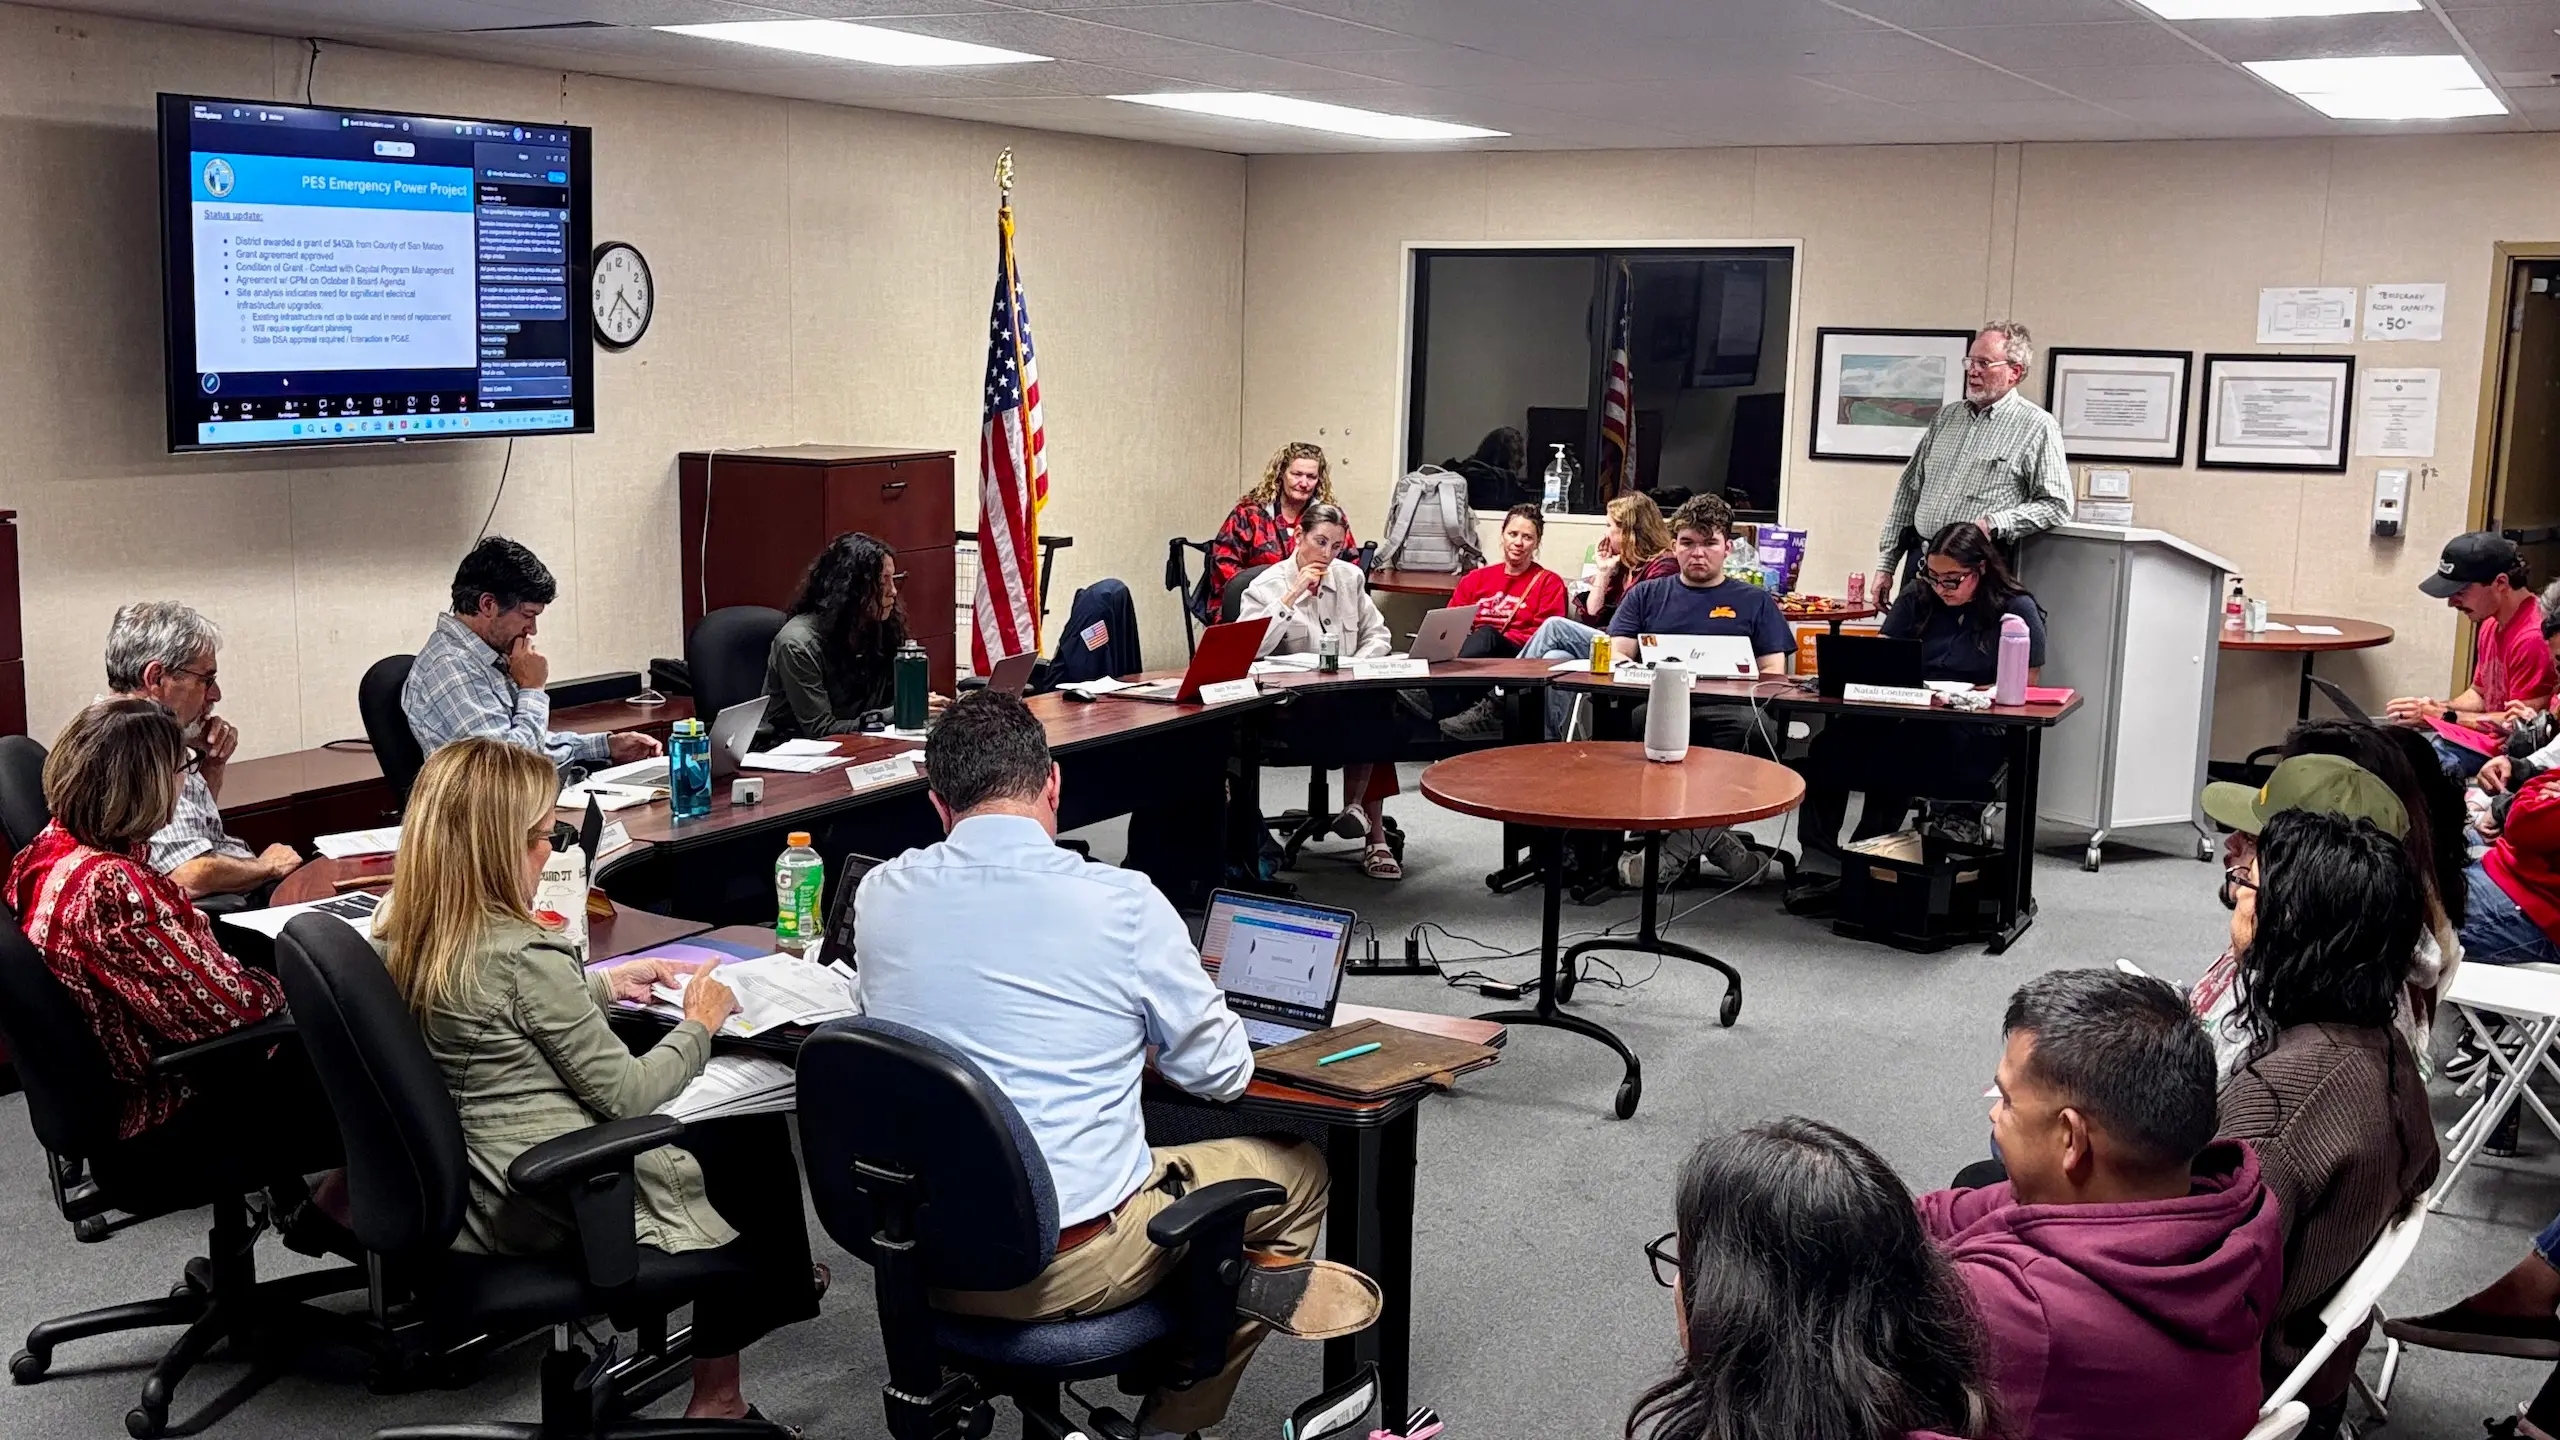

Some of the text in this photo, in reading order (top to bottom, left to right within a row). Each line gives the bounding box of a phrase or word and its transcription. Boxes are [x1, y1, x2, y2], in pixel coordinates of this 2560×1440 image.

[302, 175, 326, 190] PES
[329, 177, 391, 196] Emergency
[394, 180, 427, 194] Power
[430, 182, 467, 198] Project
[204, 209, 263, 222] Status update:
[235, 236, 261, 246] District
[263, 238, 295, 247] awarded
[304, 239, 322, 249] grant
[324, 239, 332, 247] of
[356, 240, 372, 248] from
[373, 240, 398, 251] County
[399, 241, 407, 250] of
[407, 241, 422, 250] San
[422, 242, 444, 250] Mateo
[236, 249, 334, 261] Grant agreement approved
[606, 261, 612, 272] 11
[615, 257, 622, 268] 12
[236, 262, 272, 272] Condition
[273, 263, 281, 272] of
[282, 263, 304, 272] Grant
[309, 263, 338, 273] Contact
[381, 264, 410, 276] Program
[411, 265, 455, 276] Management
[236, 275, 278, 286] Agreement
[289, 276, 308, 285] CPM
[309, 277, 320, 285] on
[320, 276, 349, 285] October
[357, 277, 378, 286] Board
[379, 277, 406, 287] Agenda
[598, 273, 606, 284] 10
[633, 272, 639, 283] 2
[236, 288, 416, 299] Site analysis indicates need for significant electrical
[595, 289, 600, 300] 9
[637, 289, 643, 301] 3
[236, 300, 286, 310] infrastructure
[599, 306, 604, 317] 8
[252, 313, 279, 323] Existing
[280, 313, 323, 321] infrastructure
[336, 314, 344, 322] up
[345, 313, 353, 321] to
[370, 313, 382, 321] and
[383, 313, 389, 321] in
[390, 313, 406, 321] need
[407, 312, 414, 321] of
[414, 313, 452, 322] replacement
[627, 317, 632, 329] 5
[252, 324, 353, 334] Will require significant planning
[617, 321, 623, 333] 6
[252, 335, 271, 344] State
[272, 335, 288, 344] DSA
[289, 335, 318, 345] approval
[318, 335, 345, 345] required
[350, 334, 383, 343] Interaction
[1881, 687, 1924, 698] Contreras
[777, 869, 792, 889] G
